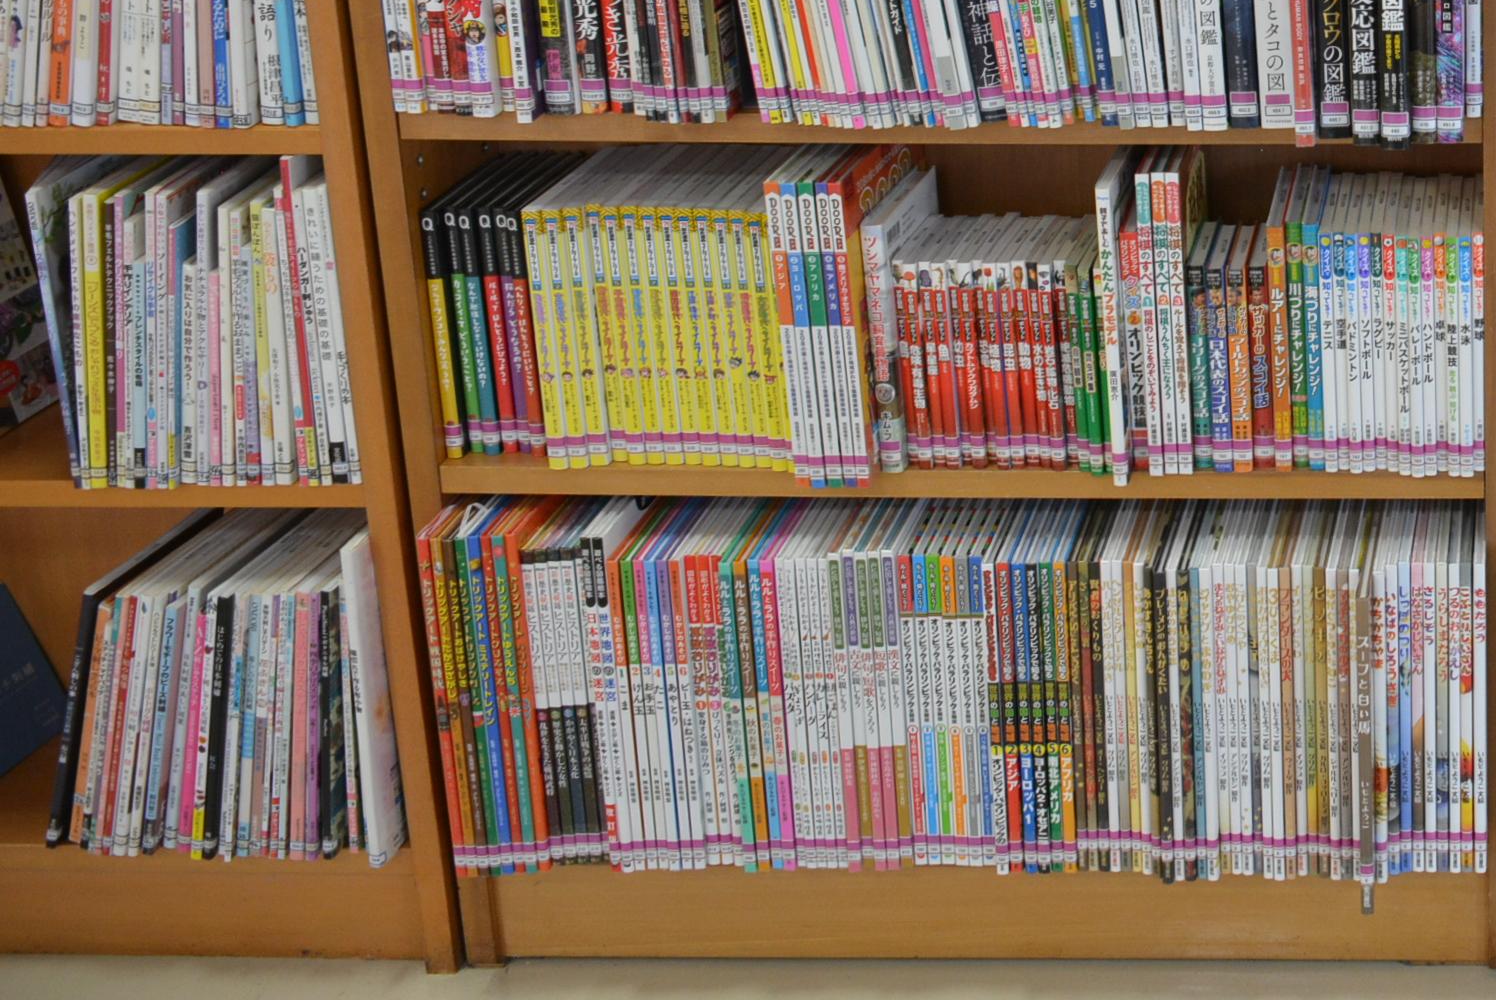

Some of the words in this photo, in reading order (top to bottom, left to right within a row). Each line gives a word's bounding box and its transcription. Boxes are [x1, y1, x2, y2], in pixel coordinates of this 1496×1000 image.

[1322, 321, 1333, 350] テニス
[1347, 323, 1359, 383] バドミントン
